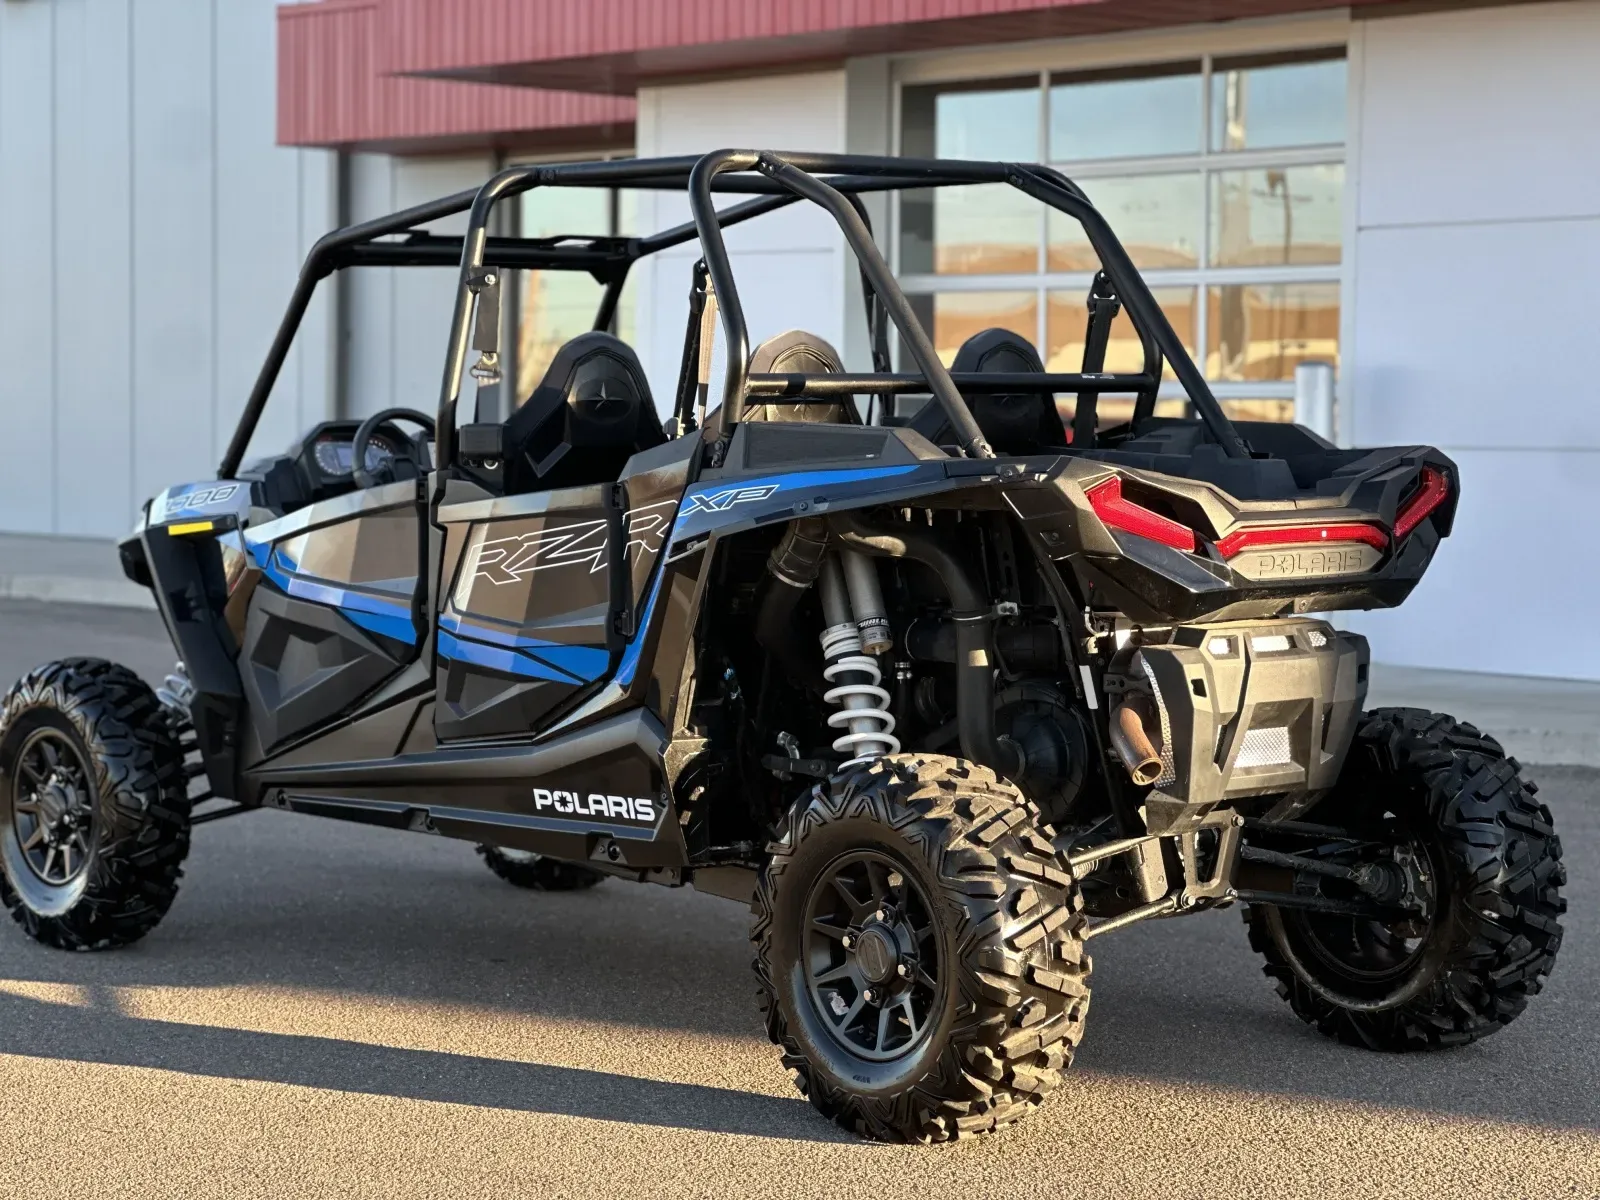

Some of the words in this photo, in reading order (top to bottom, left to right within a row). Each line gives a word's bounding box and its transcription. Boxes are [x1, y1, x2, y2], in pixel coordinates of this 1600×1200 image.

[456, 499, 679, 600] RZR
[677, 484, 780, 517] XP
[1257, 550, 1363, 577] POLARIS
[532, 788, 656, 822] POLARIS
